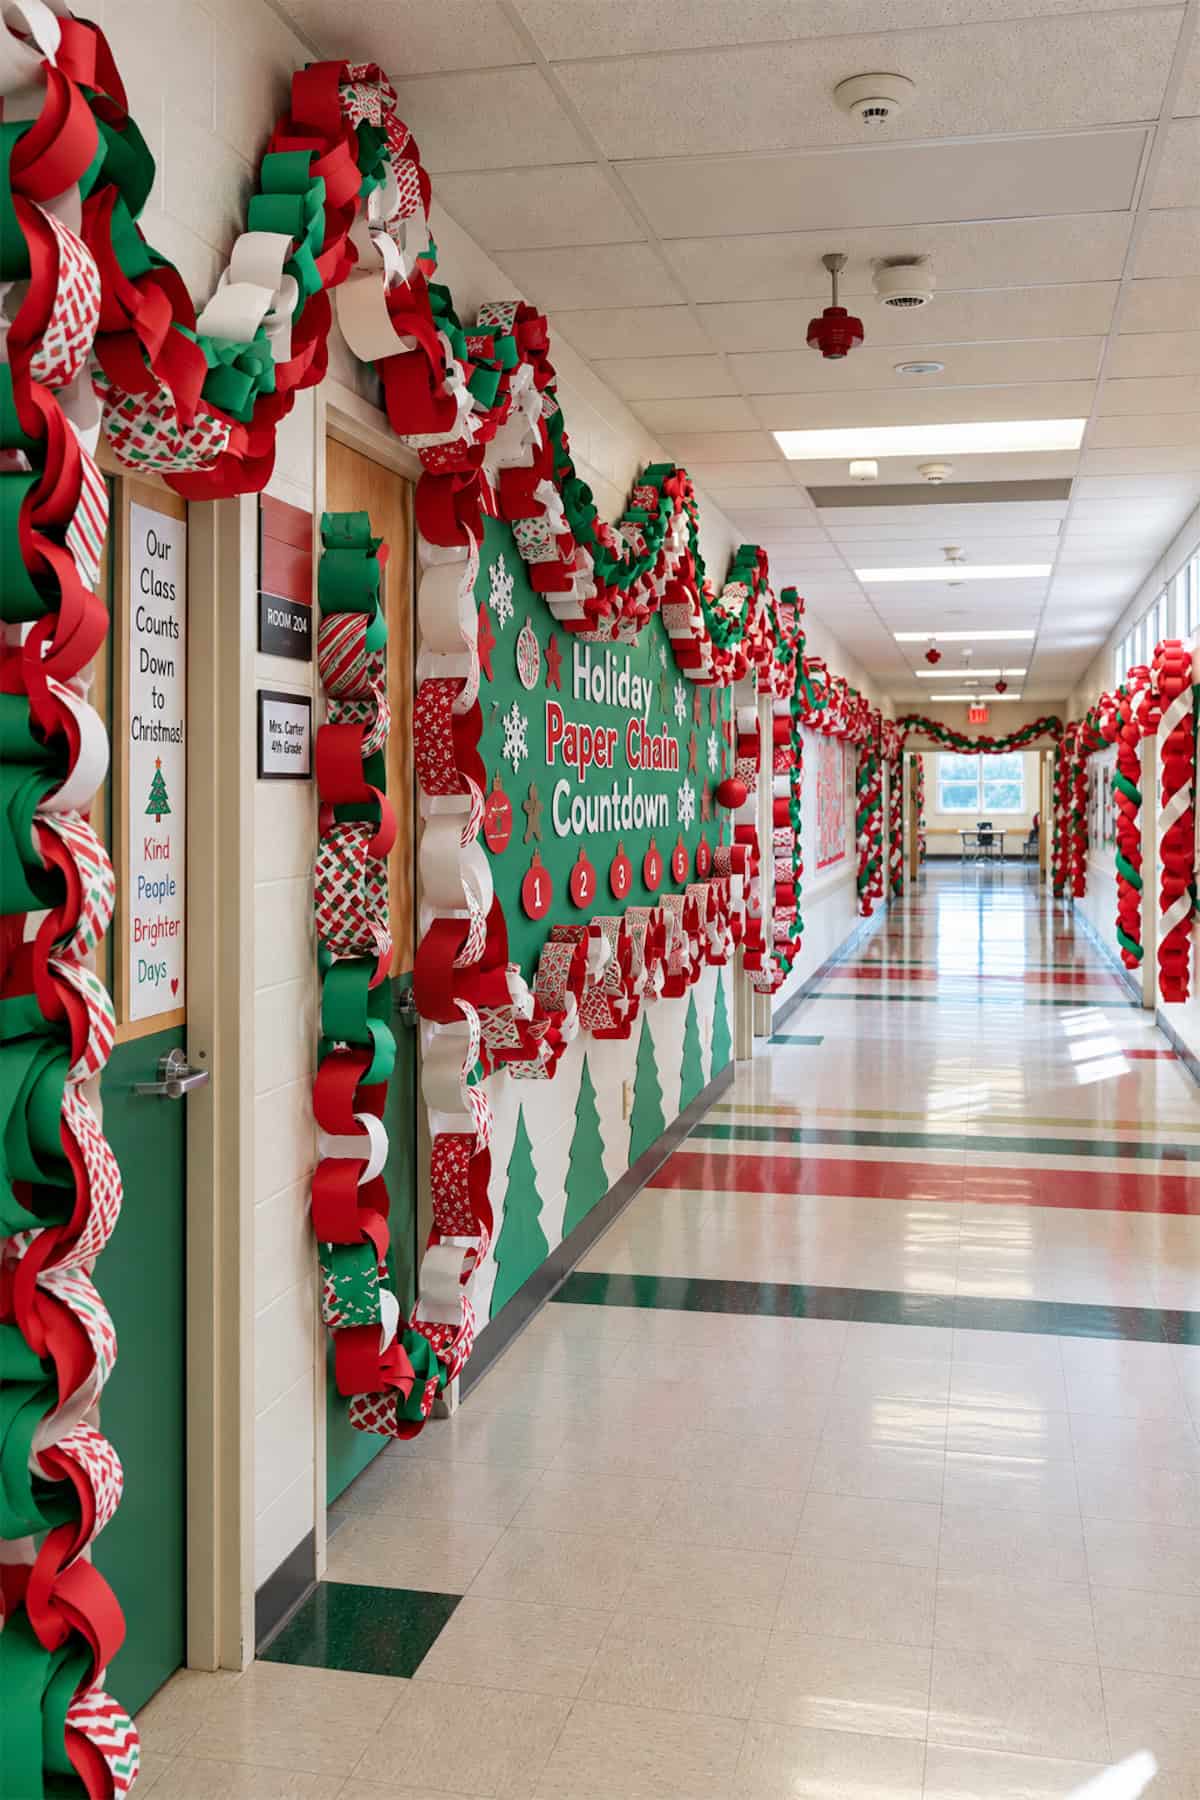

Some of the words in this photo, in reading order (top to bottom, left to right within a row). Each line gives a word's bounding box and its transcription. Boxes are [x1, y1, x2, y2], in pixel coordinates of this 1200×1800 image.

[146, 528, 172, 561] Our
[140, 567, 176, 601] Class
[136, 606, 179, 641] Counts
[267, 607, 291, 629] ROOM
[293, 615, 308, 633] 204
[139, 646, 175, 678] Down
[573, 643, 653, 721] Holiday
[151, 685, 165, 710] to
[131, 716, 183, 744] Christmas!
[269, 719, 283, 735] Mrs.
[285, 720, 305, 737] Carter
[545, 700, 618, 783] Paper
[625, 716, 679, 772] Chain
[284, 740, 302, 755] Grade
[552, 777, 670, 838] Countdown
[143, 835, 170, 861] Kind
[618, 863, 626, 890] 3
[649, 856, 657, 881] 4
[677, 851, 685, 875] 5
[137, 873, 176, 903] People
[534, 882, 542, 907] 1
[580, 871, 588, 897] 2
[134, 915, 180, 946] Brighter
[138, 959, 168, 987] Days
